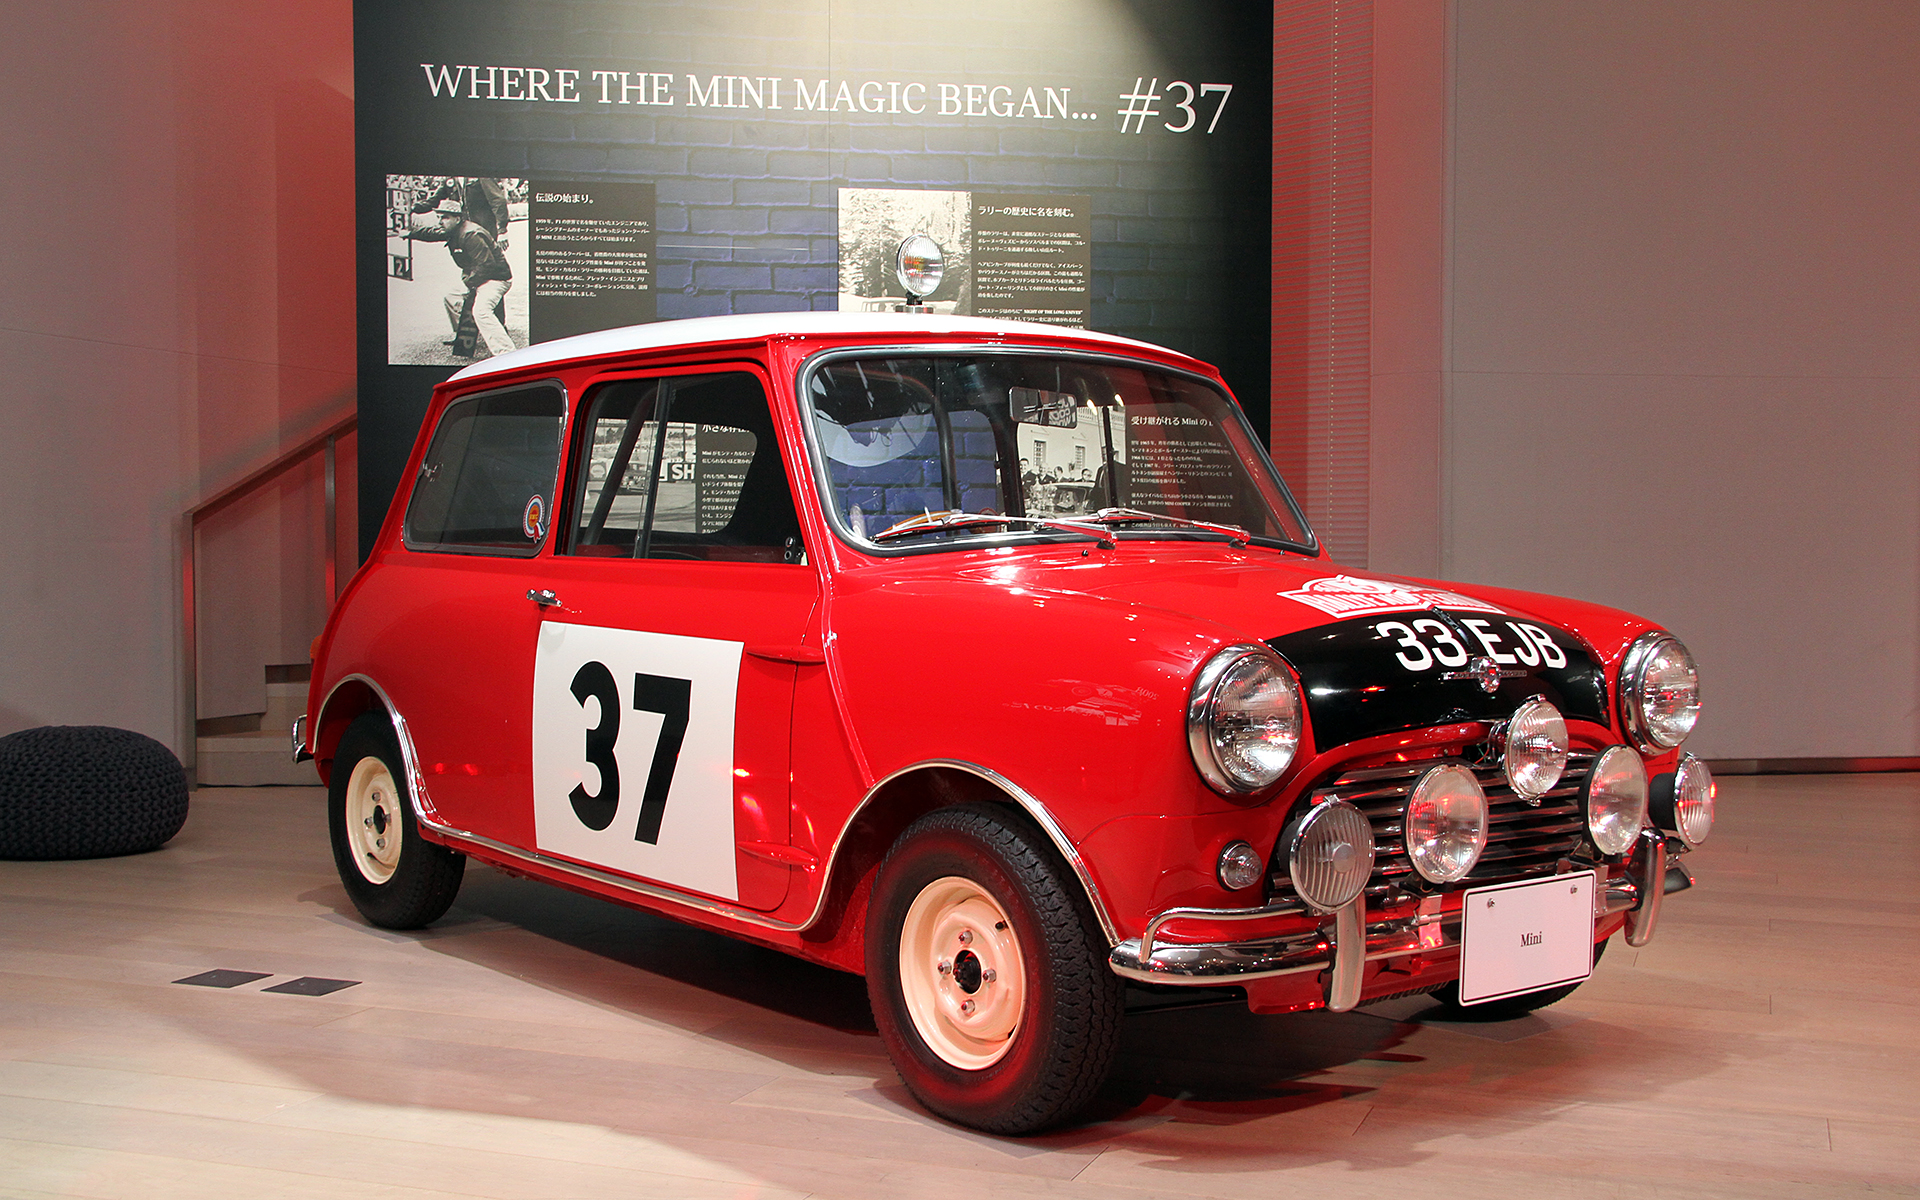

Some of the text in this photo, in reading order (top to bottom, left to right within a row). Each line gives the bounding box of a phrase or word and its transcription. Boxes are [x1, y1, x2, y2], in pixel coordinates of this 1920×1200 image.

[420, 64, 1233, 135] WHERE THE MINI MAGIC BEGAN... #37
[536, 193, 594, 204] 伝説の始まり。
[978, 206, 1074, 218] ラリーの歴史に名を刻む。
[671, 463, 695, 480] SH
[1375, 618, 1567, 671] 33 EJB
[568, 660, 692, 846] 37
[1519, 931, 1543, 947] Mini
